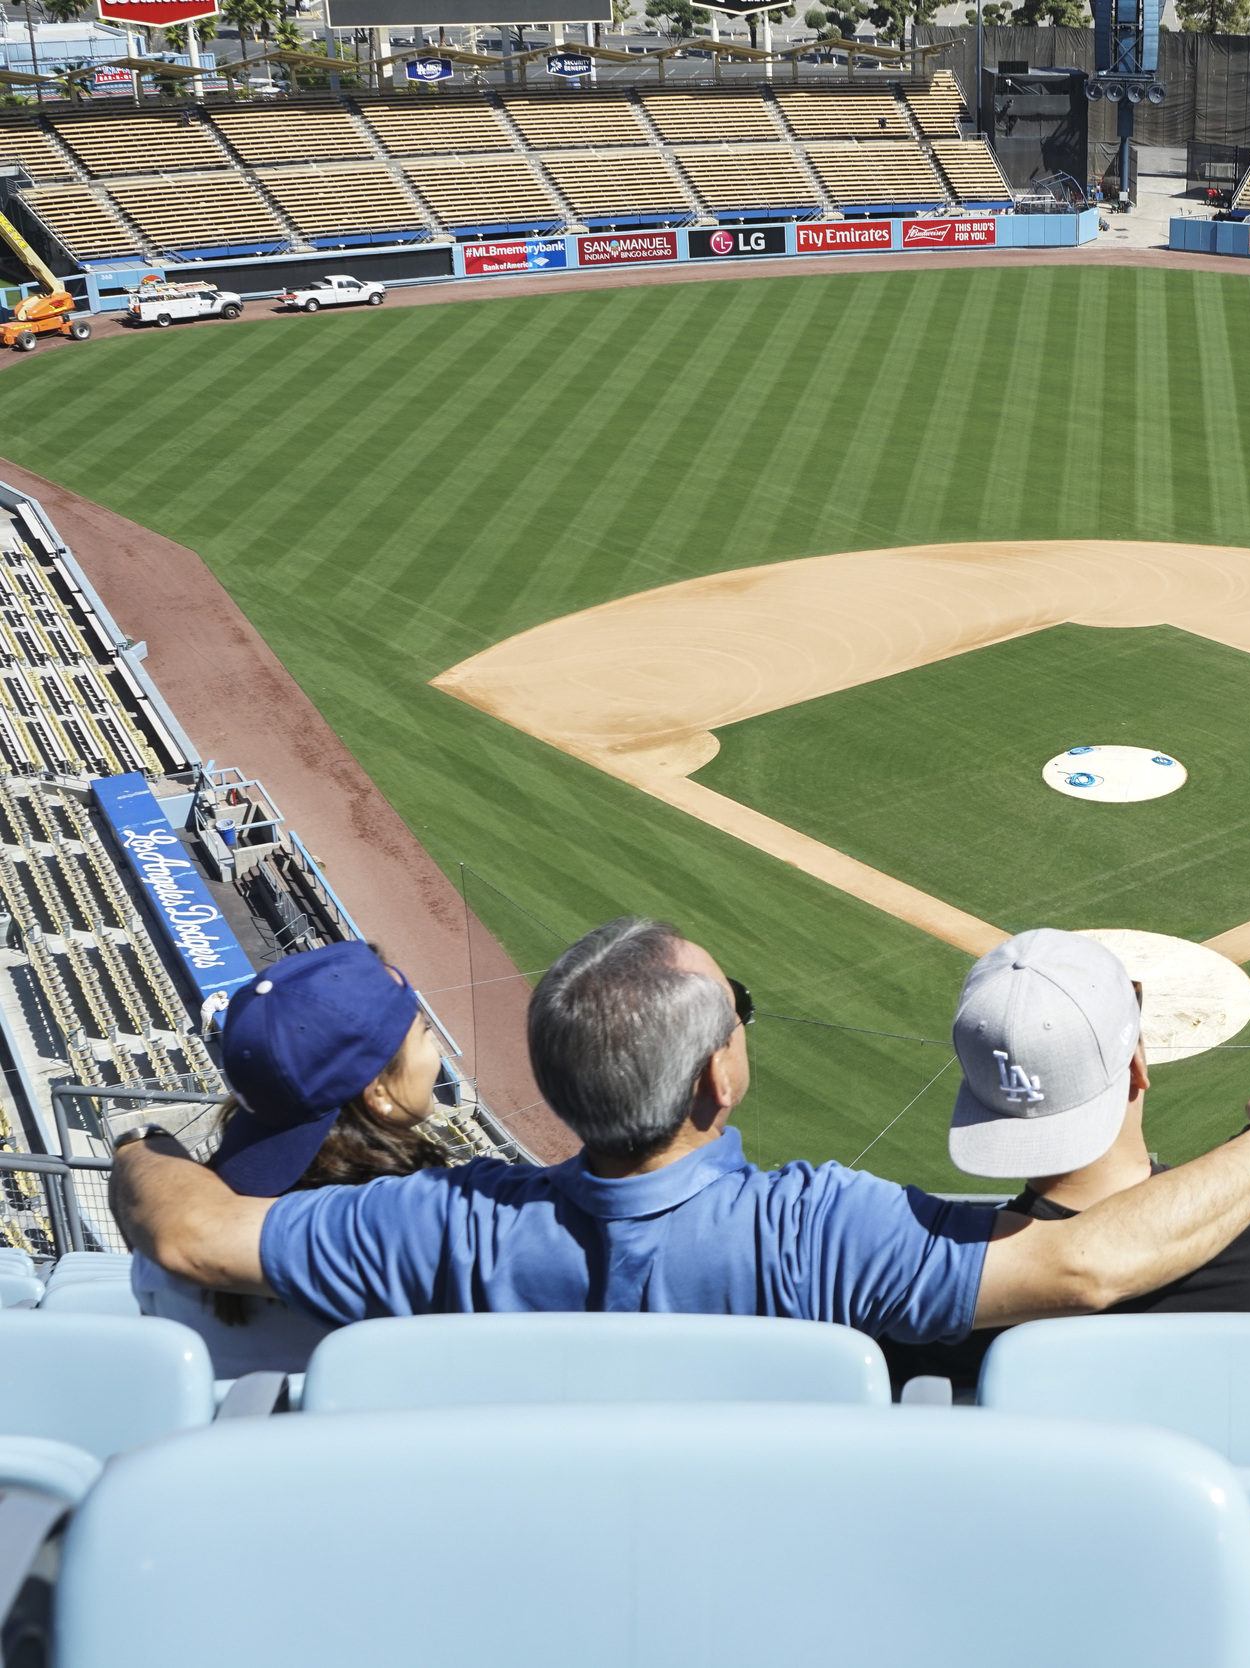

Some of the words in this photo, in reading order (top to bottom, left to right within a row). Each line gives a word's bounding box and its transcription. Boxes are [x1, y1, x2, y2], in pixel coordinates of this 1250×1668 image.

[908, 228, 946, 237] Budweiser
[955, 223, 971, 232] THIS
[973, 222, 994, 231] BUD'S
[584, 240, 610, 253] SAN
[619, 237, 671, 251] MANUEL
[738, 232, 765, 251] LG
[799, 230, 823, 247] Fly
[826, 227, 889, 243] Emirates
[955, 232, 968, 241] FOR
[970, 232, 987, 241] YOU.
[465, 240, 565, 258] #MLBmemorybank
[584, 252, 610, 261] INDIAN
[483, 263, 499, 271] Bank
[507, 261, 533, 270] America
[123, 828, 178, 858] Los
[141, 853, 195, 907] Angeles
[165, 904, 226, 969] Dodgers
[993, 1050, 1045, 1102] LA
